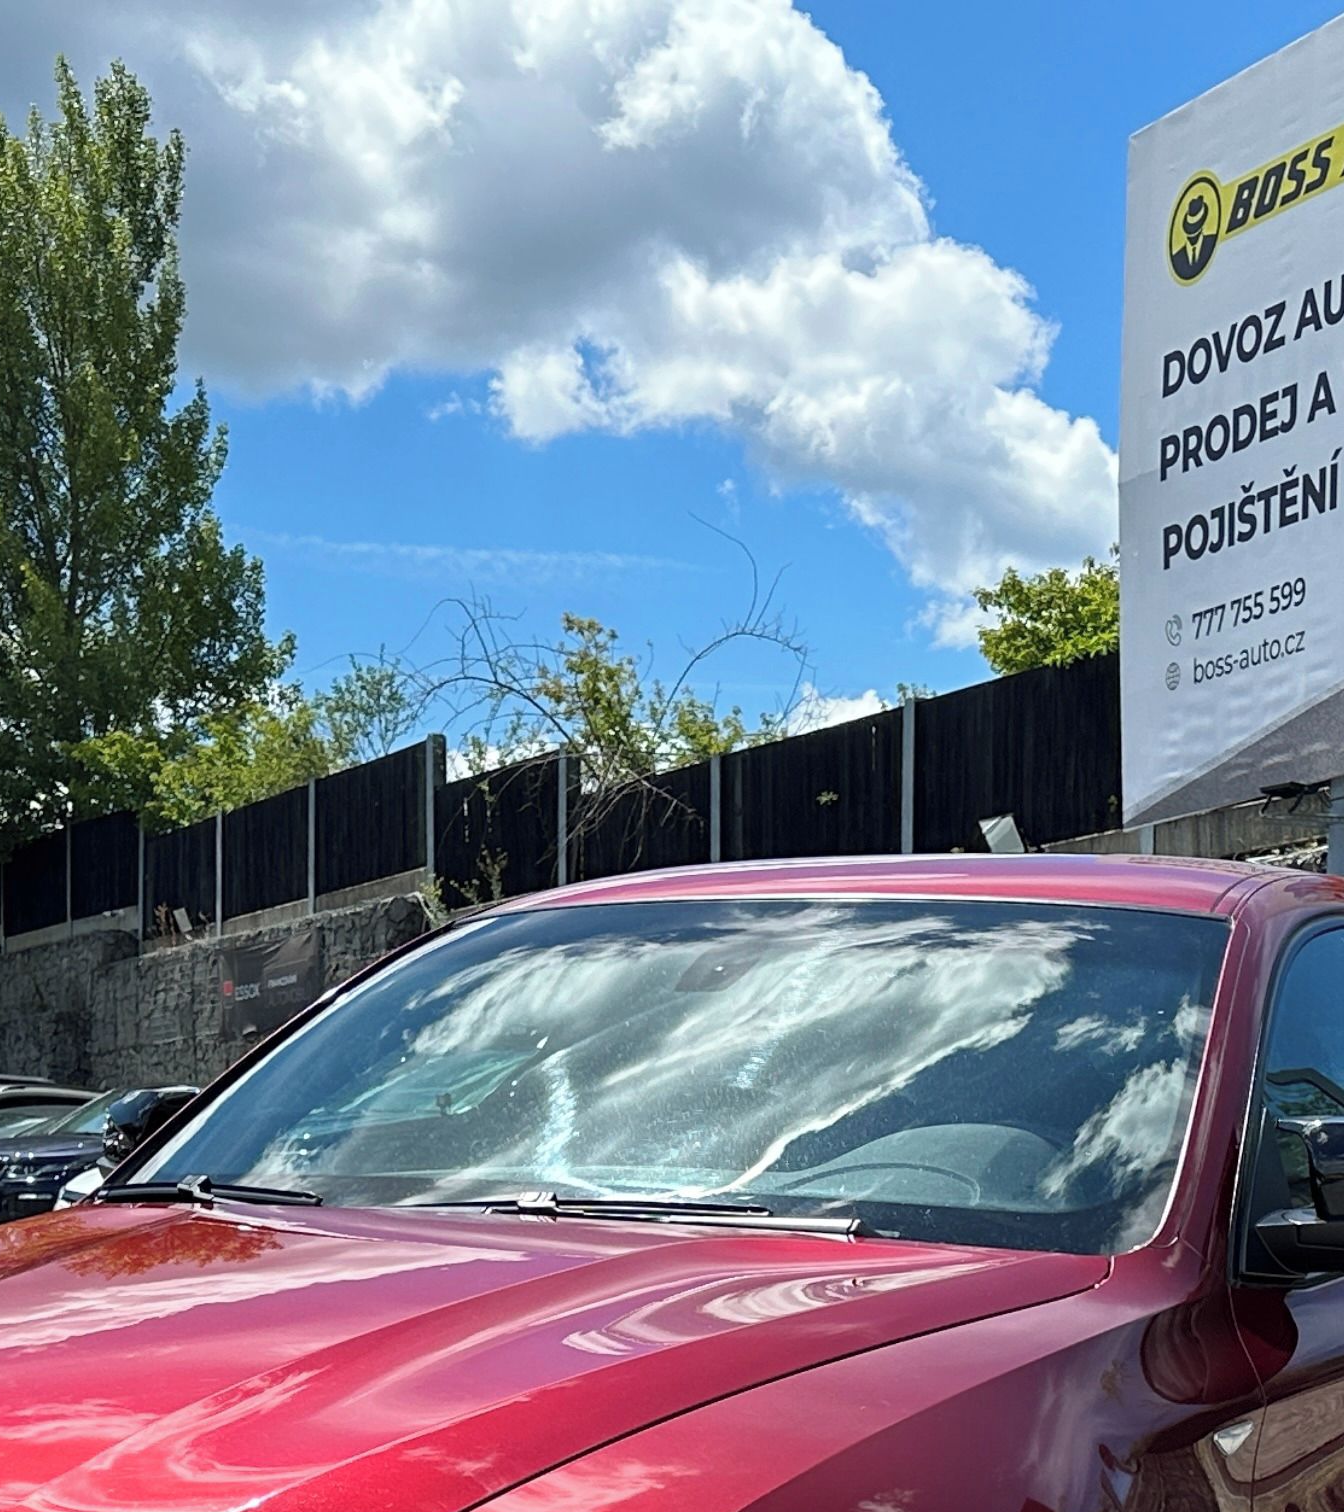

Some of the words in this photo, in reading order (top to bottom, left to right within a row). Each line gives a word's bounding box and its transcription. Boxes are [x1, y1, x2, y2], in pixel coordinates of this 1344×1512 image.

[1226, 135, 1335, 234] BOSS
[1162, 300, 1286, 398] DOVOZ
[1159, 382, 1298, 481] PRODEJ
[1306, 370, 1336, 424] A
[1162, 447, 1343, 570] POJIŠTĚNÍ
[1192, 604, 1226, 640] 777
[1230, 591, 1264, 628] 755
[1269, 577, 1306, 615] 599
[1193, 631, 1306, 685] boss-auto.cz
